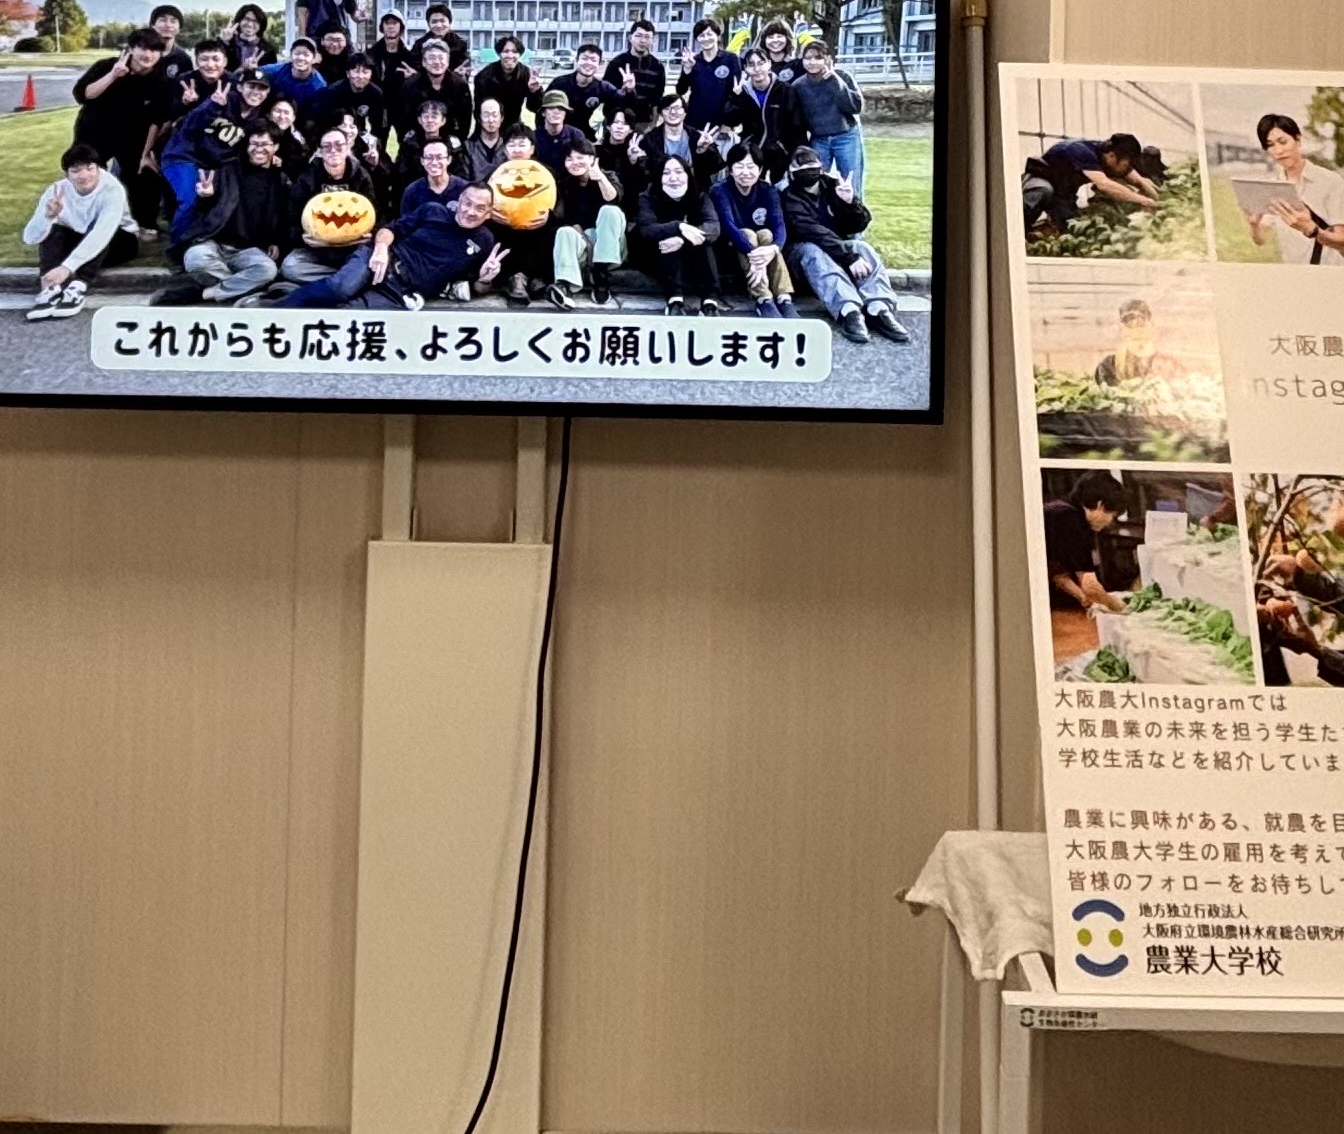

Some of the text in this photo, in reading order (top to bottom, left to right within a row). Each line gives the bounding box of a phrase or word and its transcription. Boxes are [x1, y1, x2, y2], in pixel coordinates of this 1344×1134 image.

[113, 319, 809, 370] これからも応援、よろしくお願いします！
[1054, 688, 1287, 713] 大阪農大Instagramでは
[1138, 902, 1249, 919] 地方独立行政法人
[1146, 944, 1285, 977] 農業大学校
